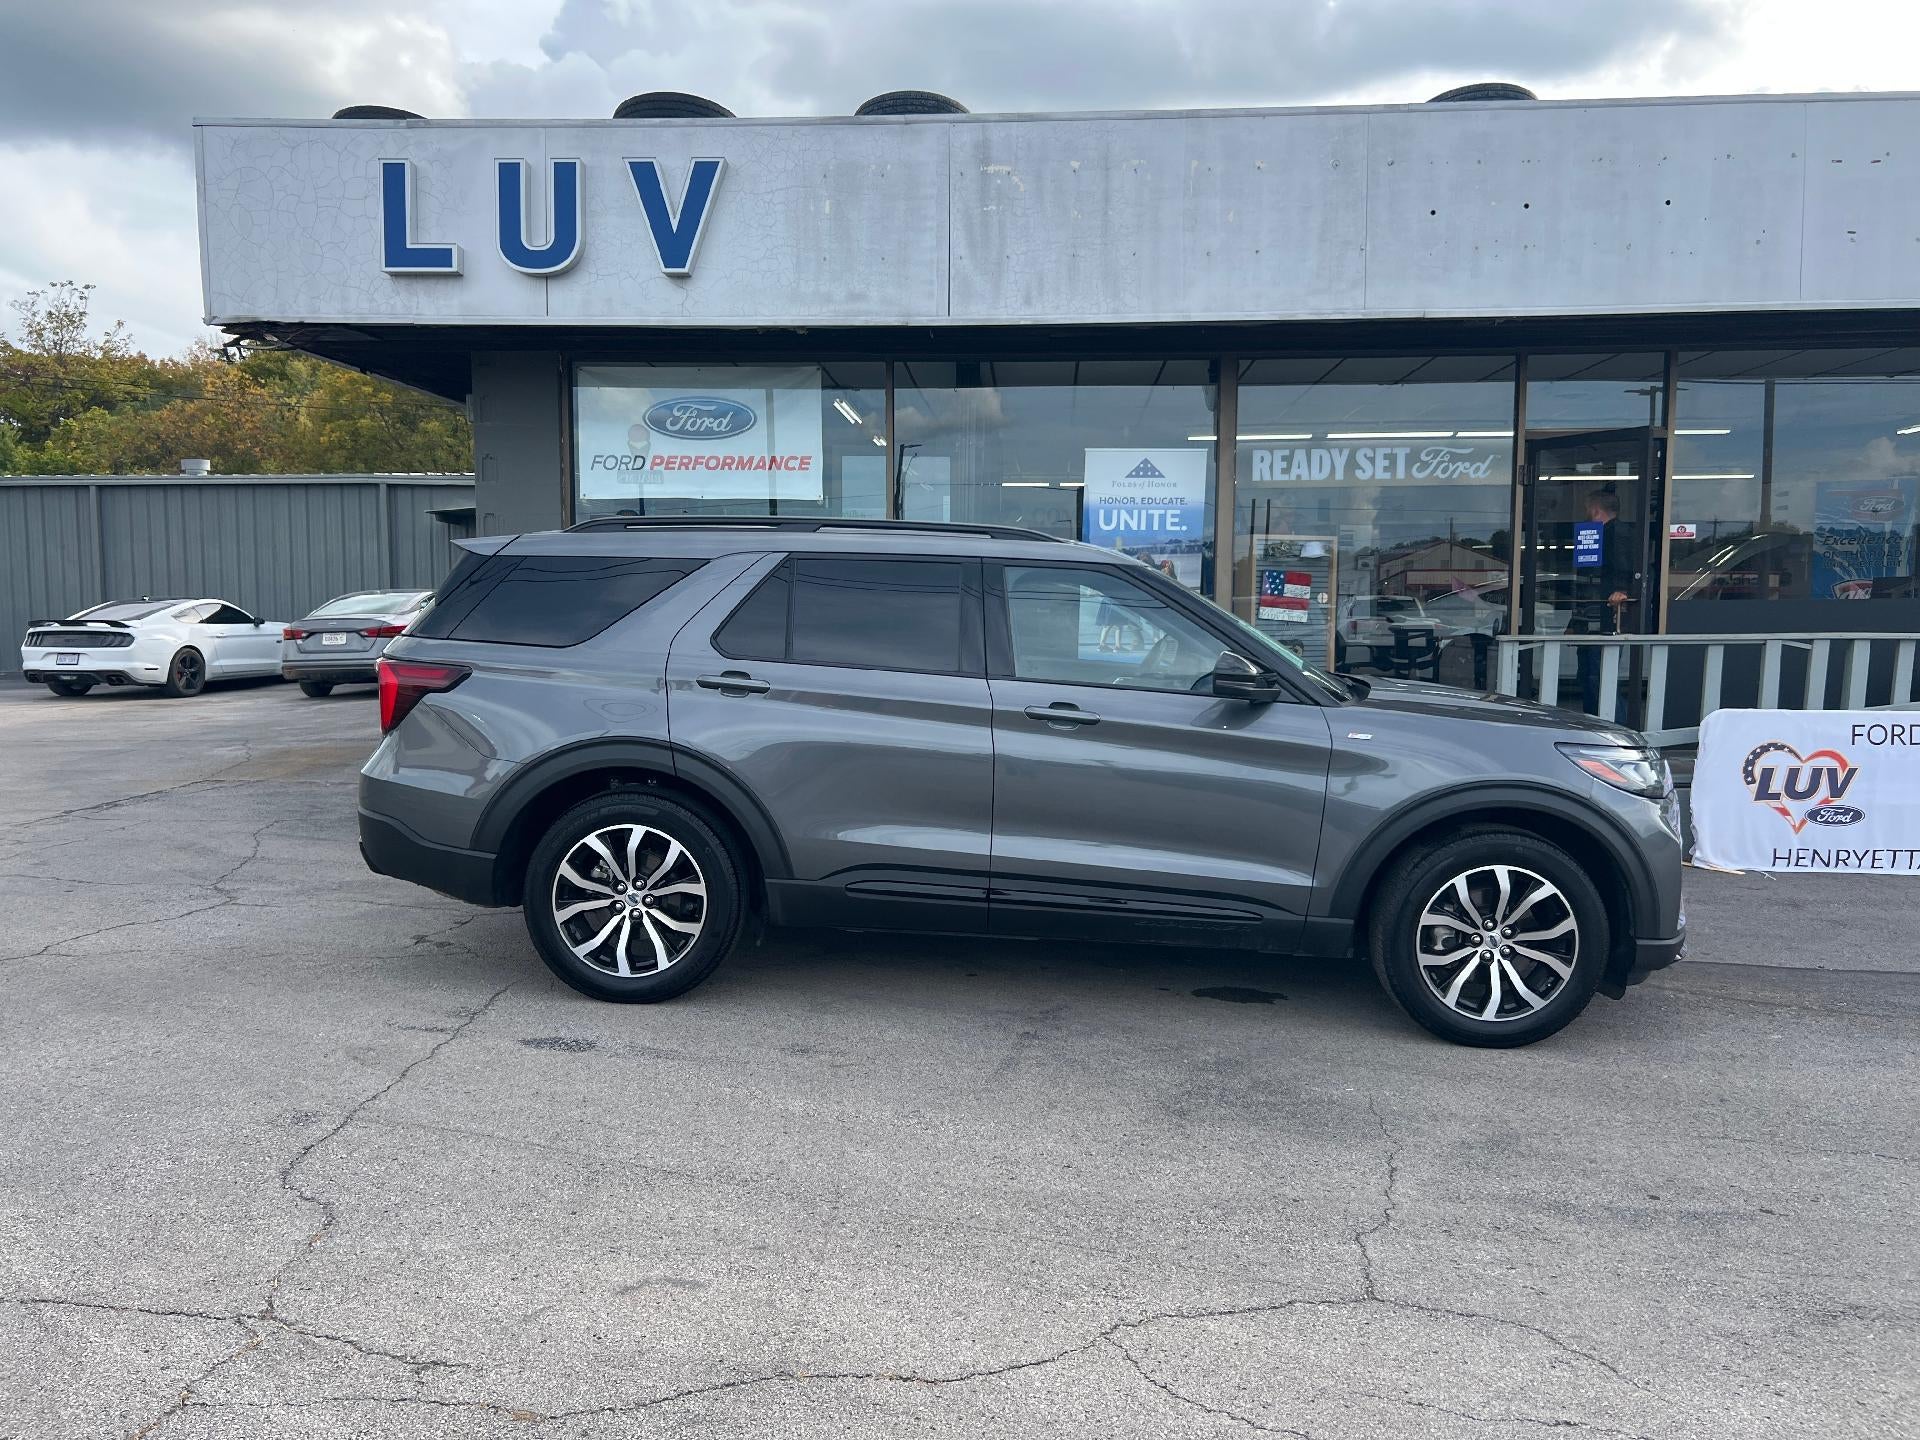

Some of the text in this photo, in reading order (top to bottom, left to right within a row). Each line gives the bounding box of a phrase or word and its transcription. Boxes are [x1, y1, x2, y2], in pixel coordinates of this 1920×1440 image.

[379, 157, 728, 278] LUV
[666, 404, 733, 432] Ford
[591, 454, 812, 471] FORD PERFORMANCE
[1252, 446, 1494, 481] READY SET Ford
[1099, 496, 1188, 505] HONOR. EDUCATE.
[1099, 509, 1188, 531] UNITE.
[1754, 768, 1858, 801] LUV
[1816, 809, 1853, 823] Ford
[1772, 848, 1920, 869] HENRYETT
